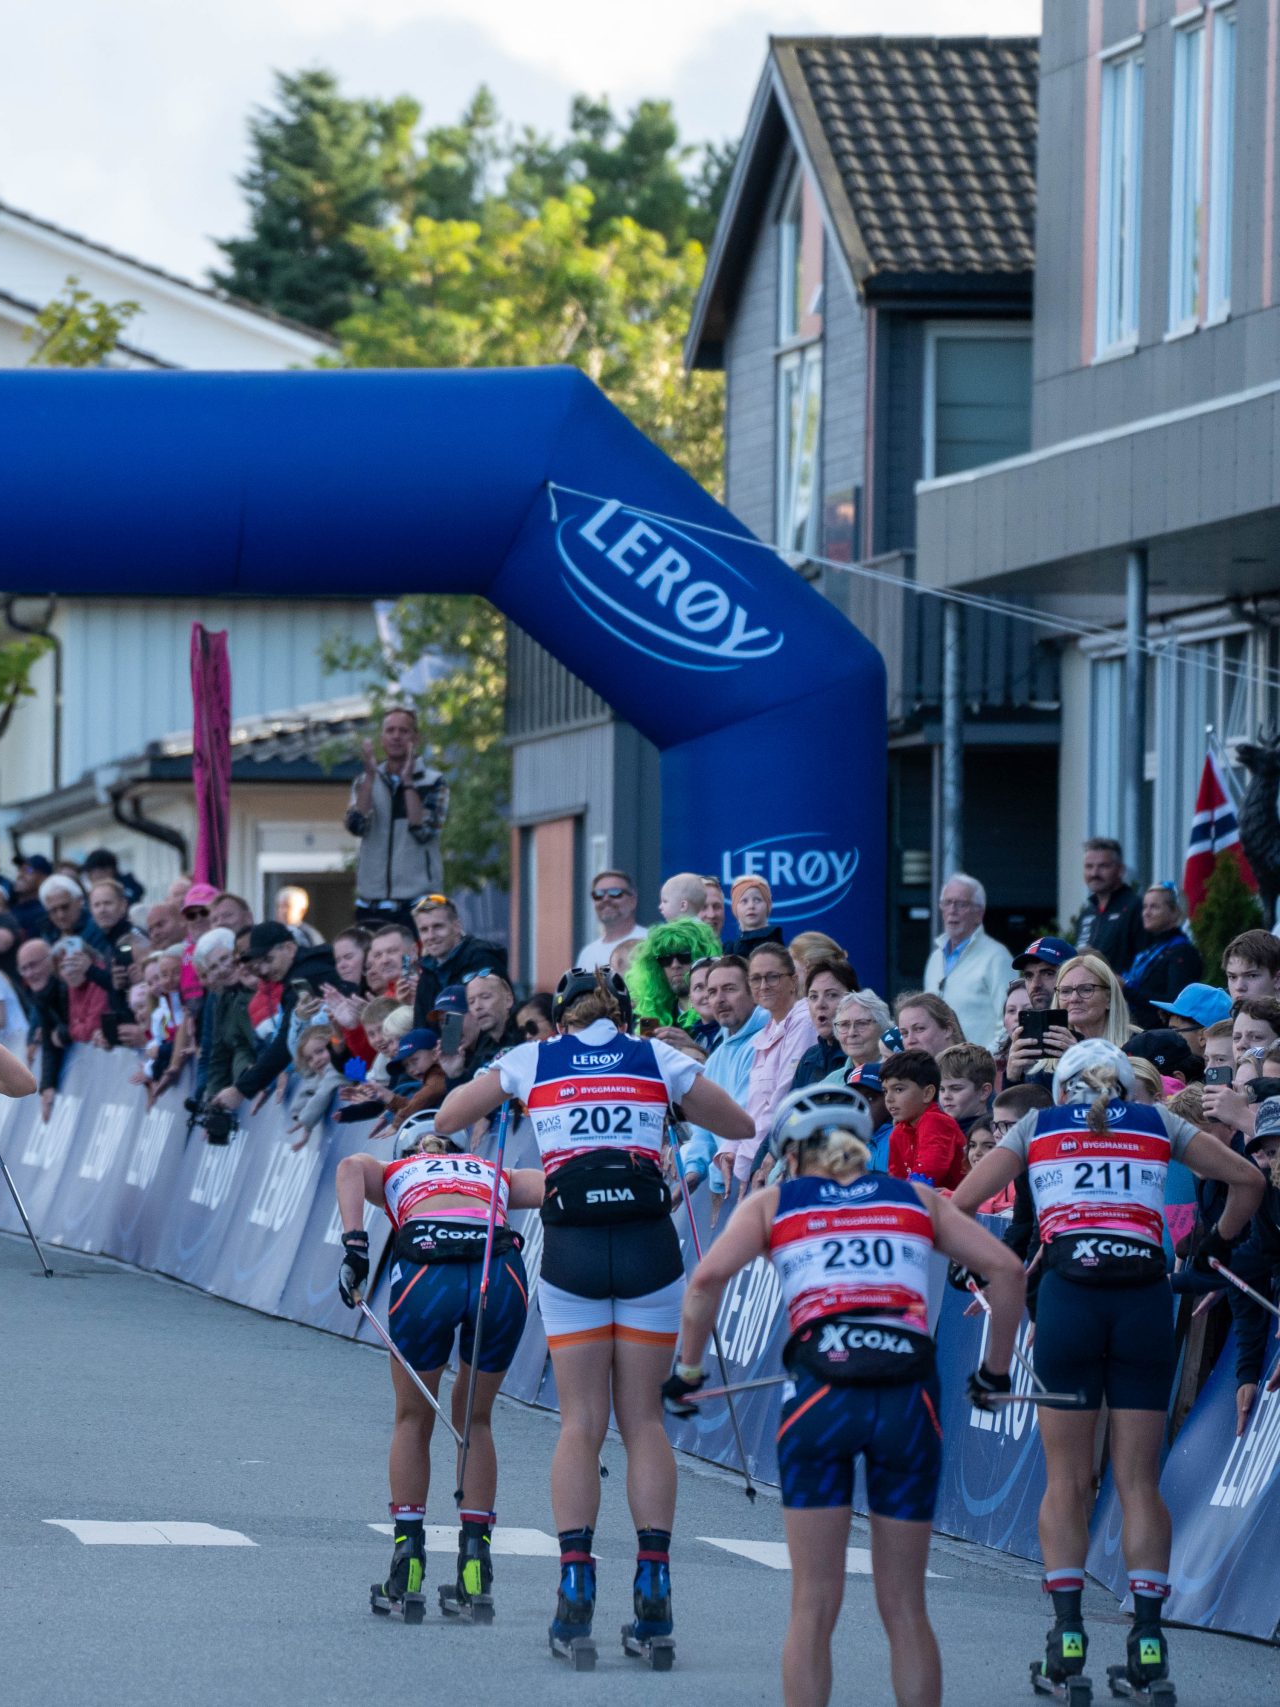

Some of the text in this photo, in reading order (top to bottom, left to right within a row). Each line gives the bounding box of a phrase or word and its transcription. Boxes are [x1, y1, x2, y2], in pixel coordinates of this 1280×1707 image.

[578, 499, 770, 655] LERØY
[722, 850, 852, 888] LERØY
[572, 1053, 621, 1066] LERØY
[560, 1086, 636, 1097] BM BYGGMAKKER
[568, 1106, 633, 1136] 202
[1060, 1141, 1139, 1151] BM BYGGMAKKER
[424, 1160, 482, 1175] 218
[1074, 1162, 1131, 1190] 211
[586, 1188, 635, 1204] SILVA
[822, 1238, 894, 1269] 230
[847, 1330, 915, 1354] COXA
